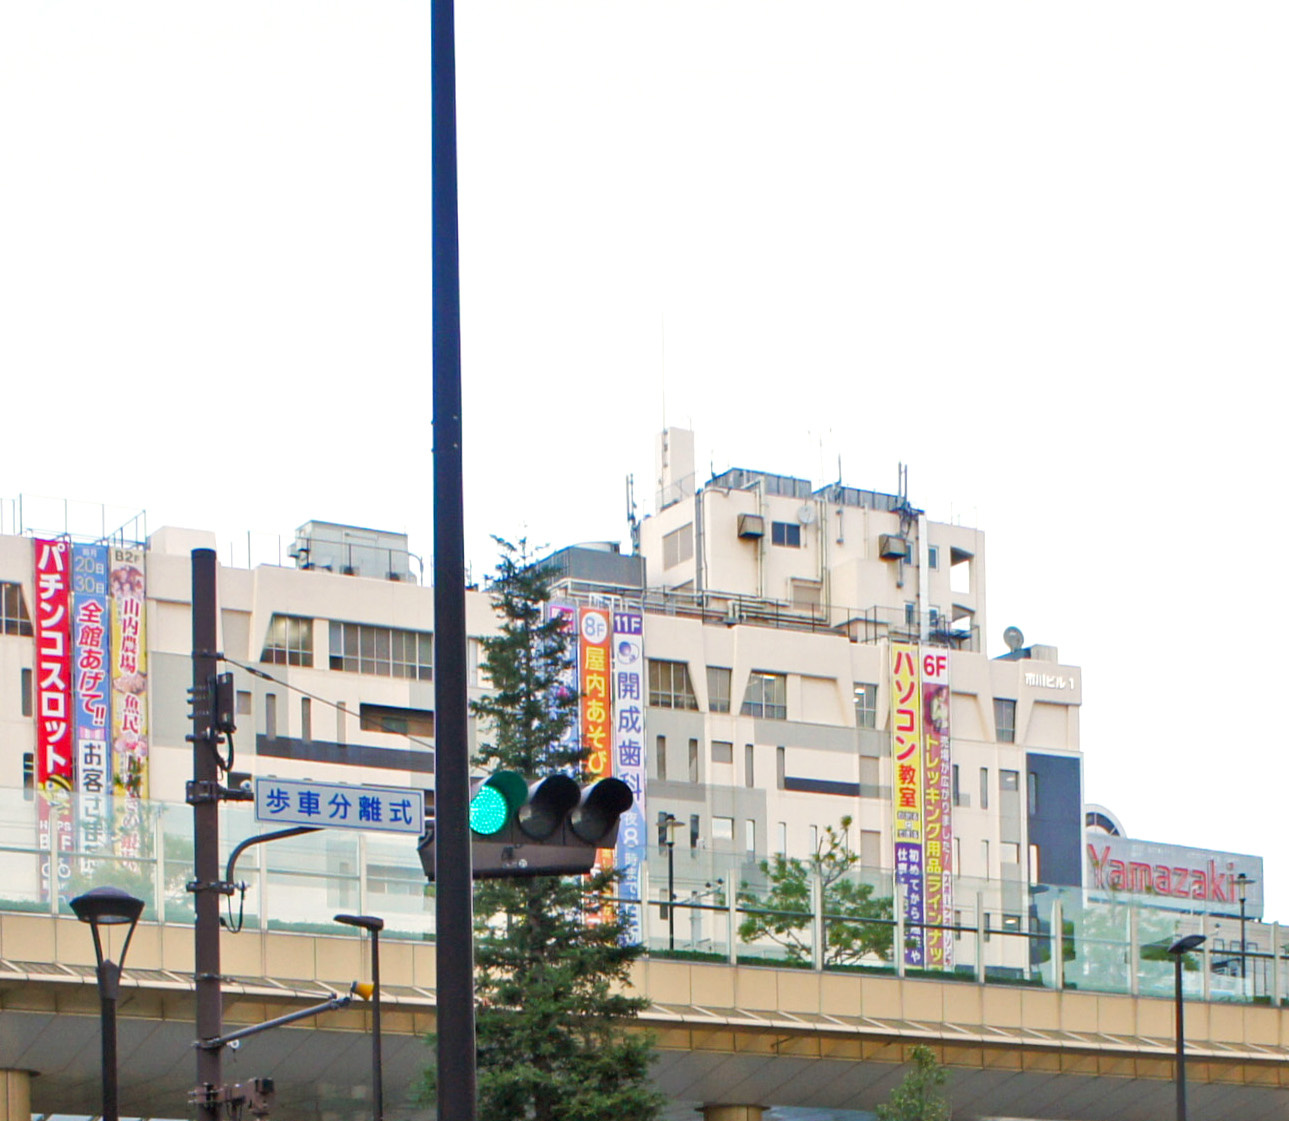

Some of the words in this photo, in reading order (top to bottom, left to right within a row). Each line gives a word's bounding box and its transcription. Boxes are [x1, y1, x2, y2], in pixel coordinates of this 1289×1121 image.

[115, 550, 140, 564] B2F
[584, 616, 605, 638] 8F
[614, 615, 642, 633] 11F
[38, 543, 67, 774] パチンコスロット
[923, 655, 947, 677] 6F
[585, 646, 607, 782] 屋内あそび
[618, 671, 642, 802] 開成歯科
[266, 787, 413, 825] 歩車分離式
[1087, 843, 1237, 903] Yamazaki
